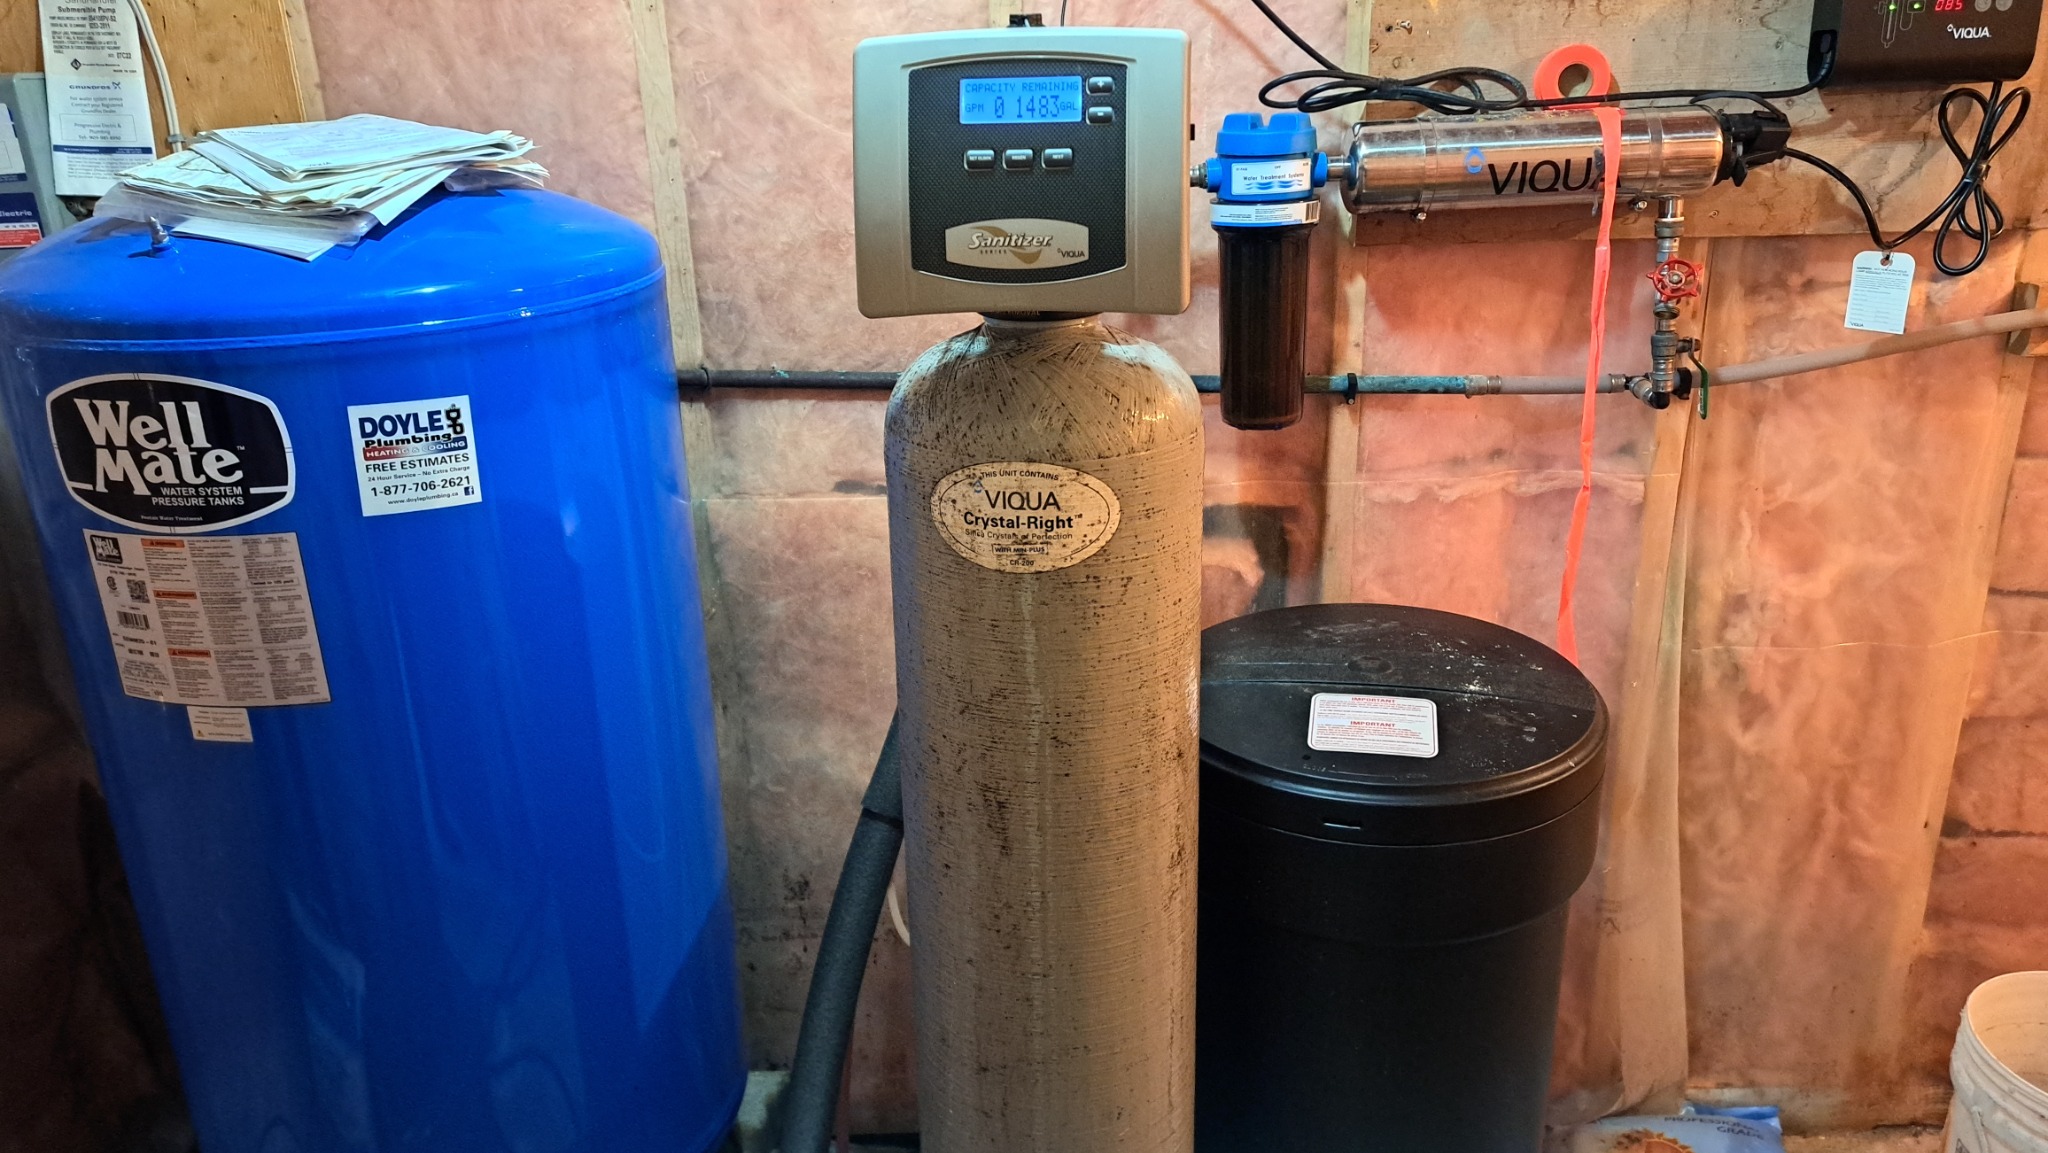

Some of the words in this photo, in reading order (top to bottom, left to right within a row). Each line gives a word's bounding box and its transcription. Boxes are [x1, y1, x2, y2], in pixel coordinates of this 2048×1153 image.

[98, 6, 116, 14] Pump
[1953, 26, 1990, 39] VIQUA
[965, 83, 1016, 94] CAPACITY
[1022, 81, 1079, 92] REMAINING
[964, 103, 984, 113] GPM
[994, 96, 1005, 119] 0
[1016, 95, 1060, 119] 1483
[1059, 101, 1079, 111] GAL
[968, 232, 1053, 250] Sanitizer
[1060, 250, 1085, 259] VIQUA
[73, 398, 212, 450] Well
[358, 409, 444, 439] DOYLE
[364, 432, 452, 448] Plumbing
[366, 448, 410, 458] HEATING
[421, 440, 466, 452] COOLING
[95, 445, 244, 496] Mate
[365, 461, 397, 473] FREE
[400, 453, 470, 470] ESTIMATES
[393, 472, 416, 480] Service
[449, 465, 470, 473] Charge
[980, 470, 998, 479] THIS
[999, 469, 1018, 478] UNIT
[1019, 470, 1060, 481] CONTAINS
[160, 486, 197, 496] WATER
[198, 486, 243, 496] SYSTEM
[370, 475, 471, 497] 1-877-706-2621
[151, 496, 207, 506] PRESSURE
[209, 496, 245, 506] TANKS
[388, 491, 459, 505] www.doyleplumbing.ca
[984, 490, 1061, 512] VIQUA
[1350, 720, 1396, 728] IMPORTANT
